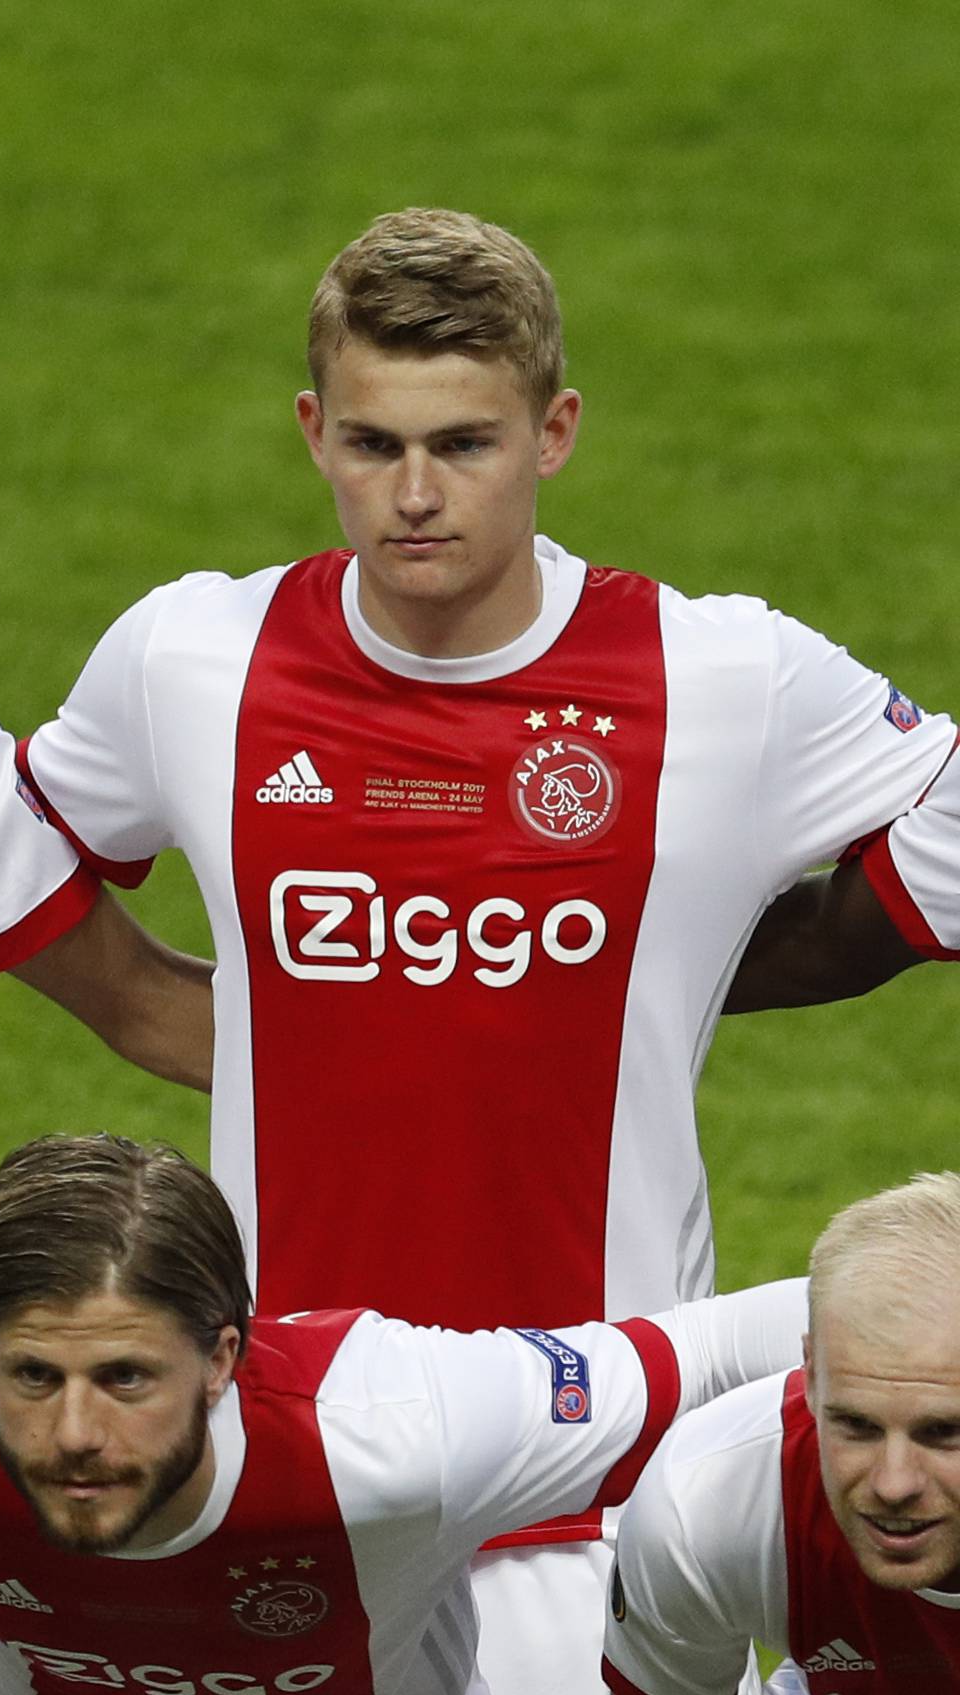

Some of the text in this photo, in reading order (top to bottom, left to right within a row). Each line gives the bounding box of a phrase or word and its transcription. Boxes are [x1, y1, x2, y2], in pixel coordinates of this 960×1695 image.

[516, 740, 565, 785] AJAX
[255, 783, 334, 804] adidas
[365, 778, 486, 793] FINAL STOCKHOLM 2017
[365, 789, 405, 800] FRIENDS
[407, 791, 440, 801] ARENA
[449, 793, 460, 803] 24
[462, 795, 484, 804] MAY
[571, 804, 610, 839] AMSTERDAM
[270, 869, 607, 988] Ziggo
